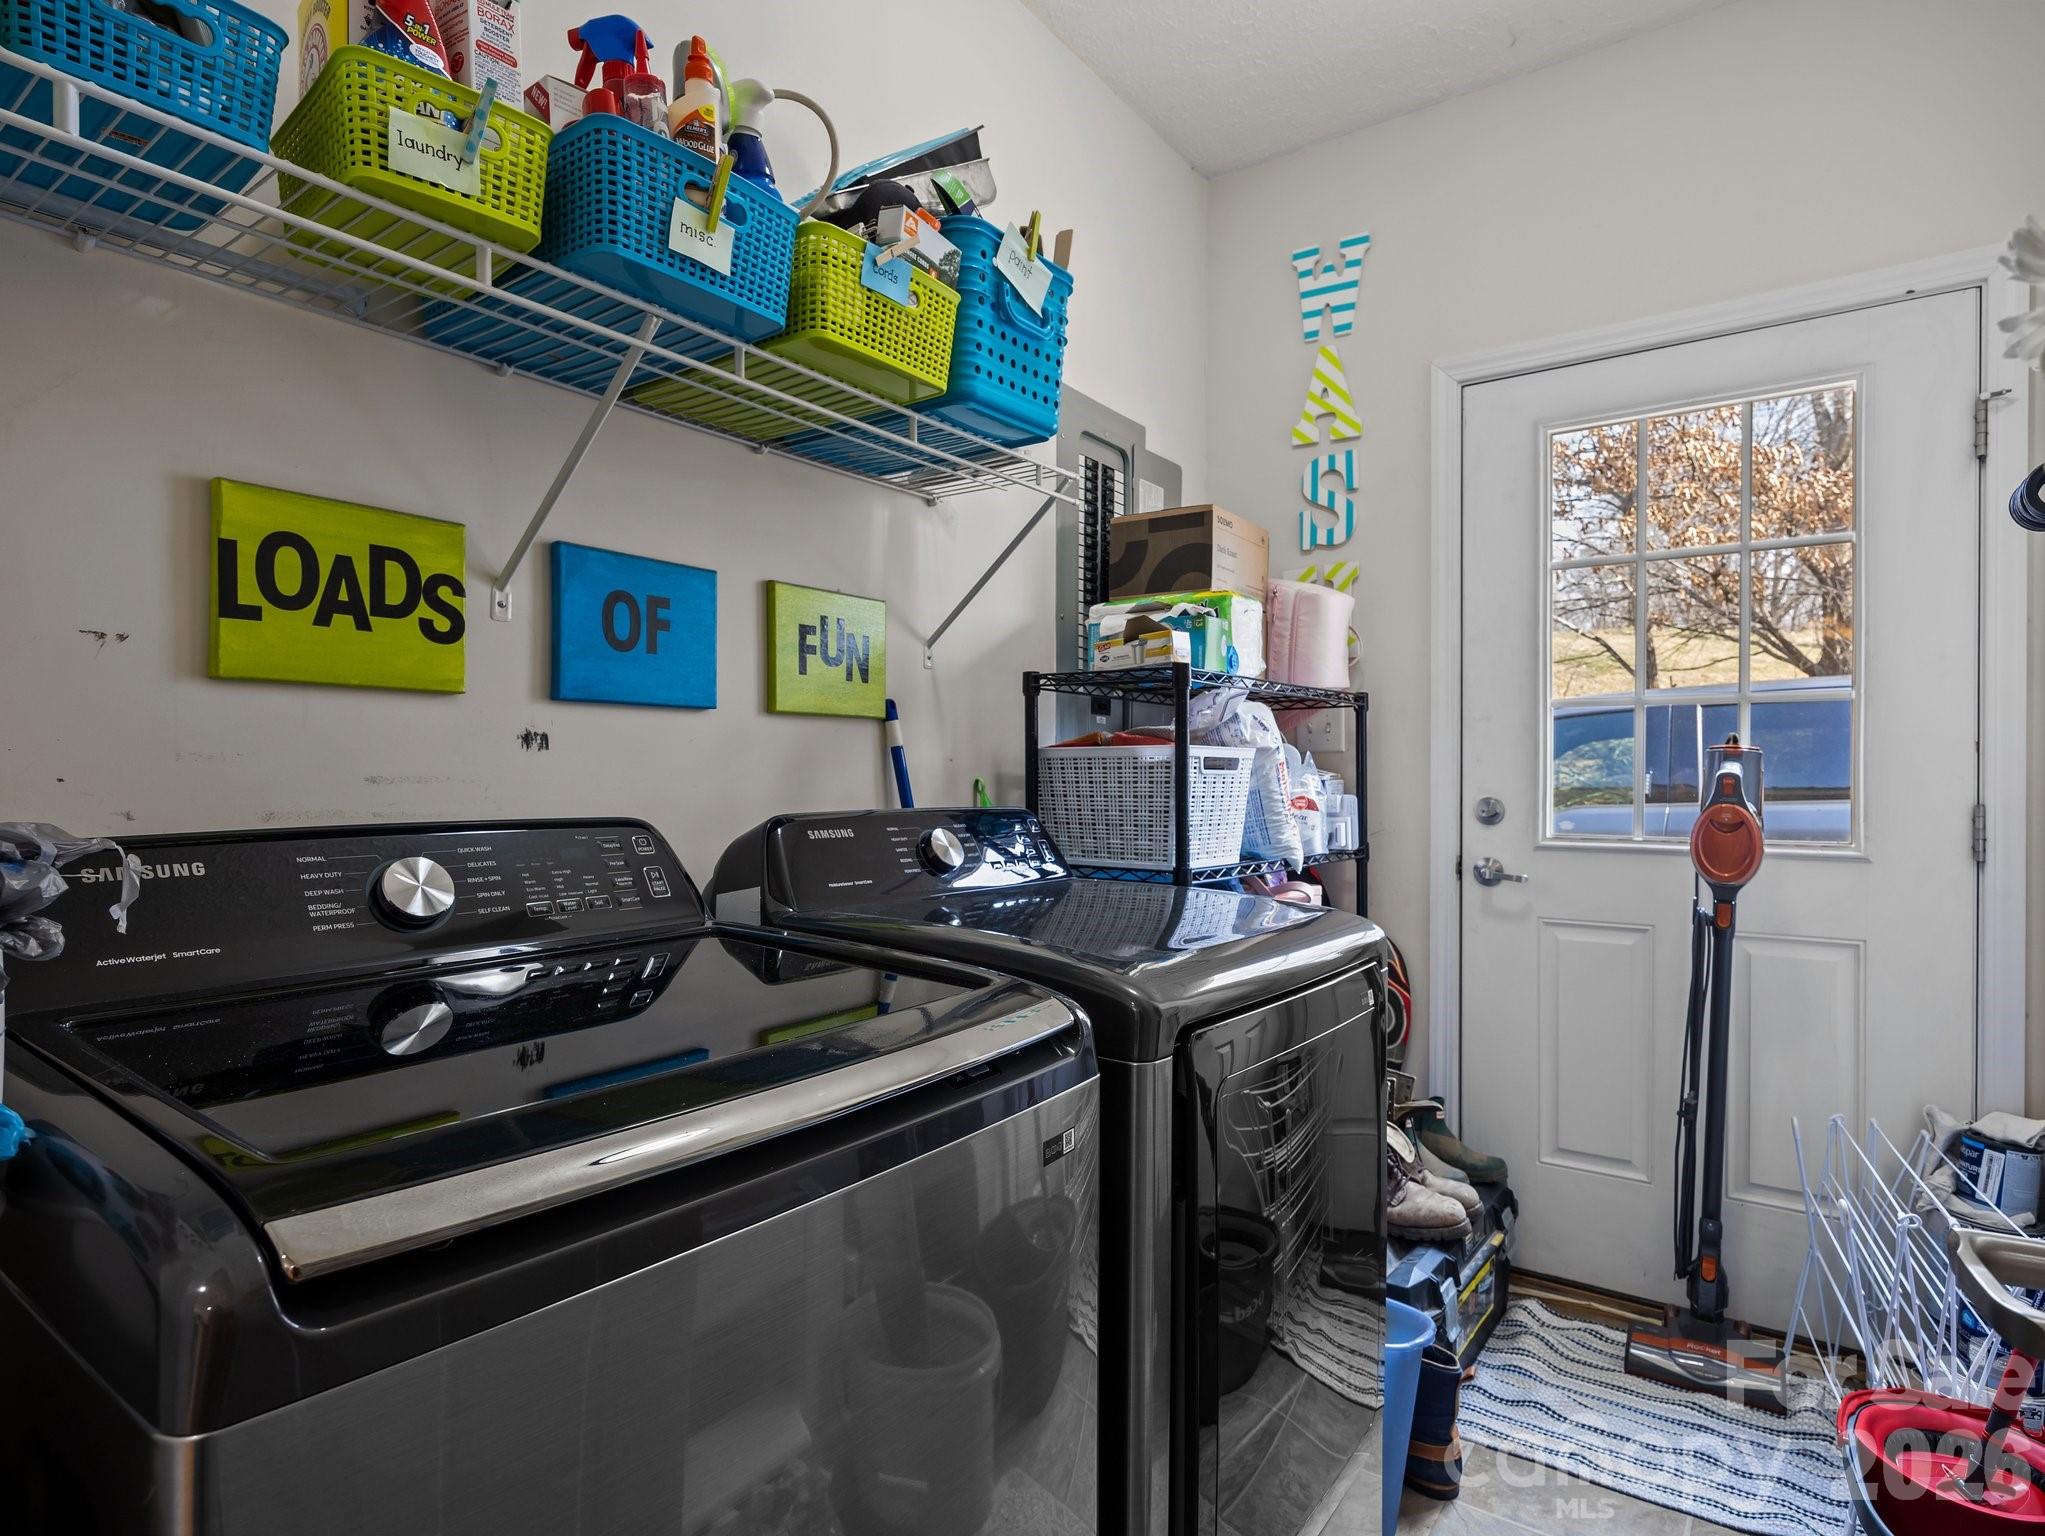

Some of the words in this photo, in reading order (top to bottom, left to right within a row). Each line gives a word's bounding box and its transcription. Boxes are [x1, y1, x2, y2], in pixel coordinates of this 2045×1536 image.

[477, 6, 515, 34] BORAX
[406, 25, 438, 46] POWER
[530, 84, 548, 110] NEW!
[396, 129, 464, 171] laundry
[676, 138, 698, 149] WOOD
[698, 141, 715, 154] GLUE
[680, 221, 717, 248] misc.
[1008, 248, 1035, 280] paint
[1283, 232, 1371, 600] WAS
[217, 530, 467, 646] LOADS
[601, 589, 671, 655] OF
[798, 614, 870, 684] FUN
[807, 828, 855, 840] SAMSUNG
[467, 860, 497, 868] DELICATES
[300, 872, 324, 880] HEAVY
[309, 908, 356, 917] WATERPROOF
[491, 905, 511, 913] CLEAN
[313, 924, 333, 932] PERM
[96, 952, 167, 967] ActiveWaterjet
[172, 947, 221, 958] SmartCare
